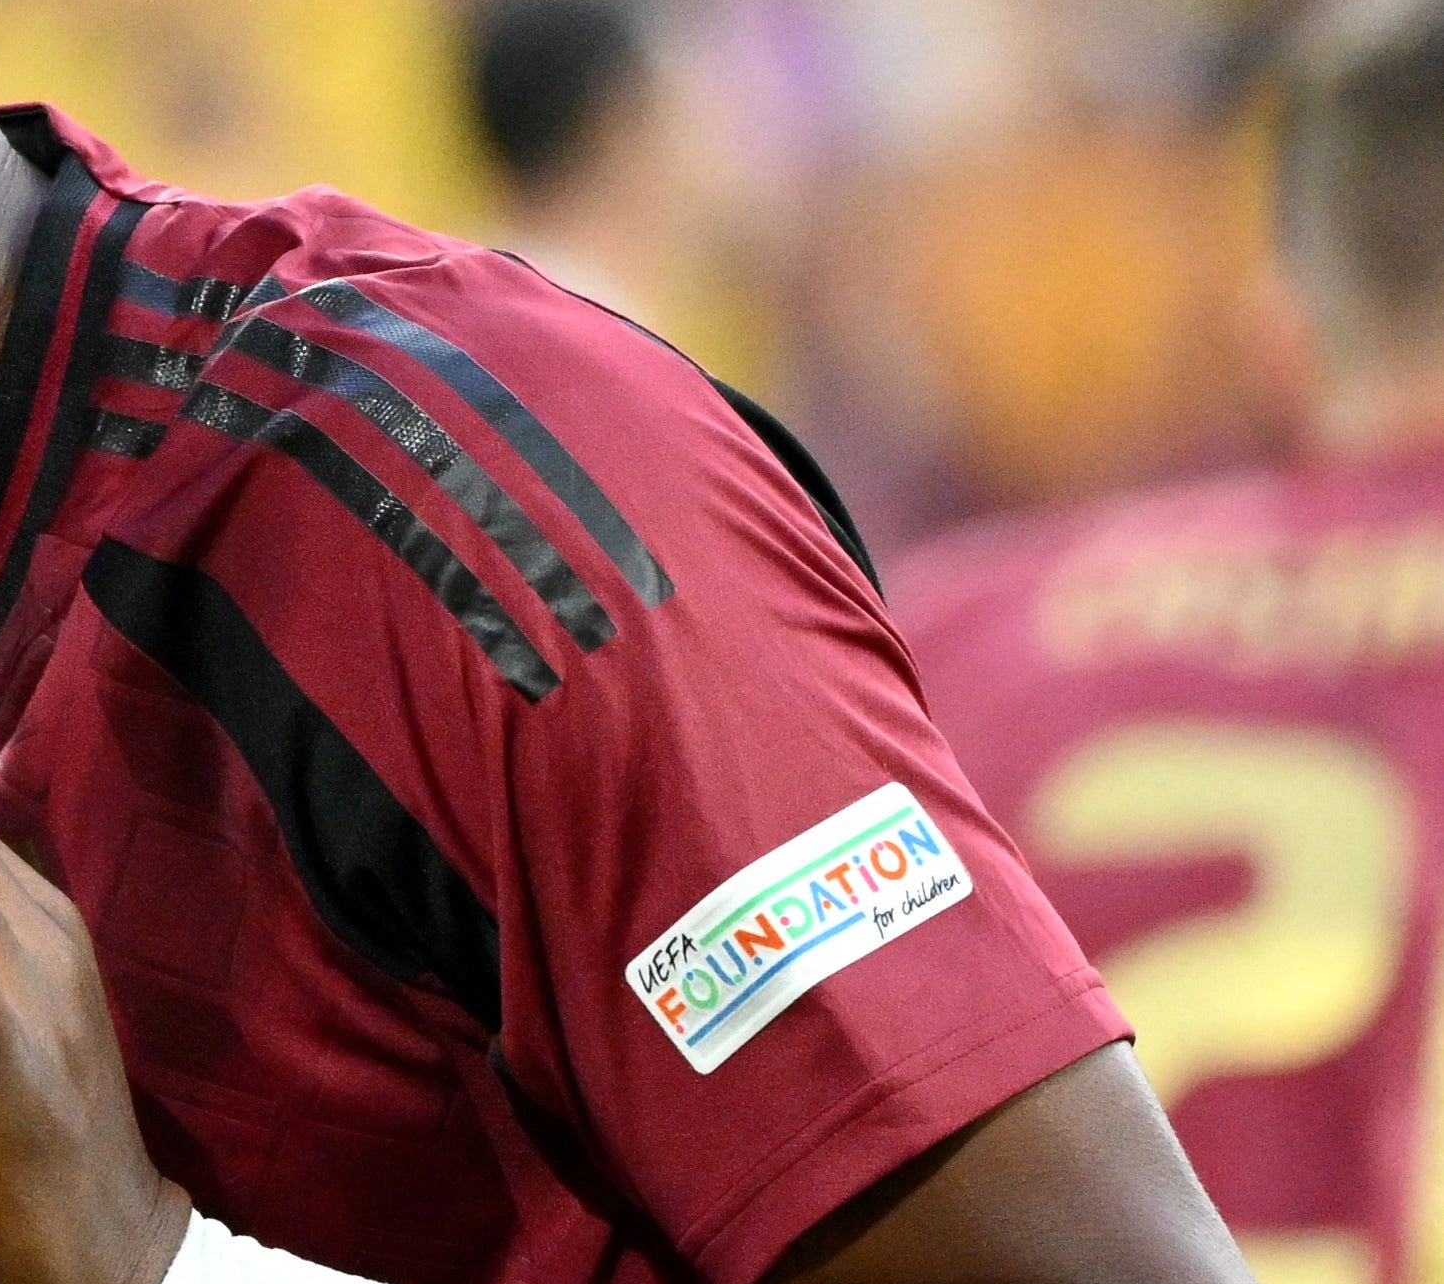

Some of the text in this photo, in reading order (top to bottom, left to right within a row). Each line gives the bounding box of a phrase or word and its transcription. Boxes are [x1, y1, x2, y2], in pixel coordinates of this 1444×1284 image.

[655, 819, 942, 1035] FOUNDATION
[872, 873, 961, 939] for children
[637, 933, 698, 994] UEFA
